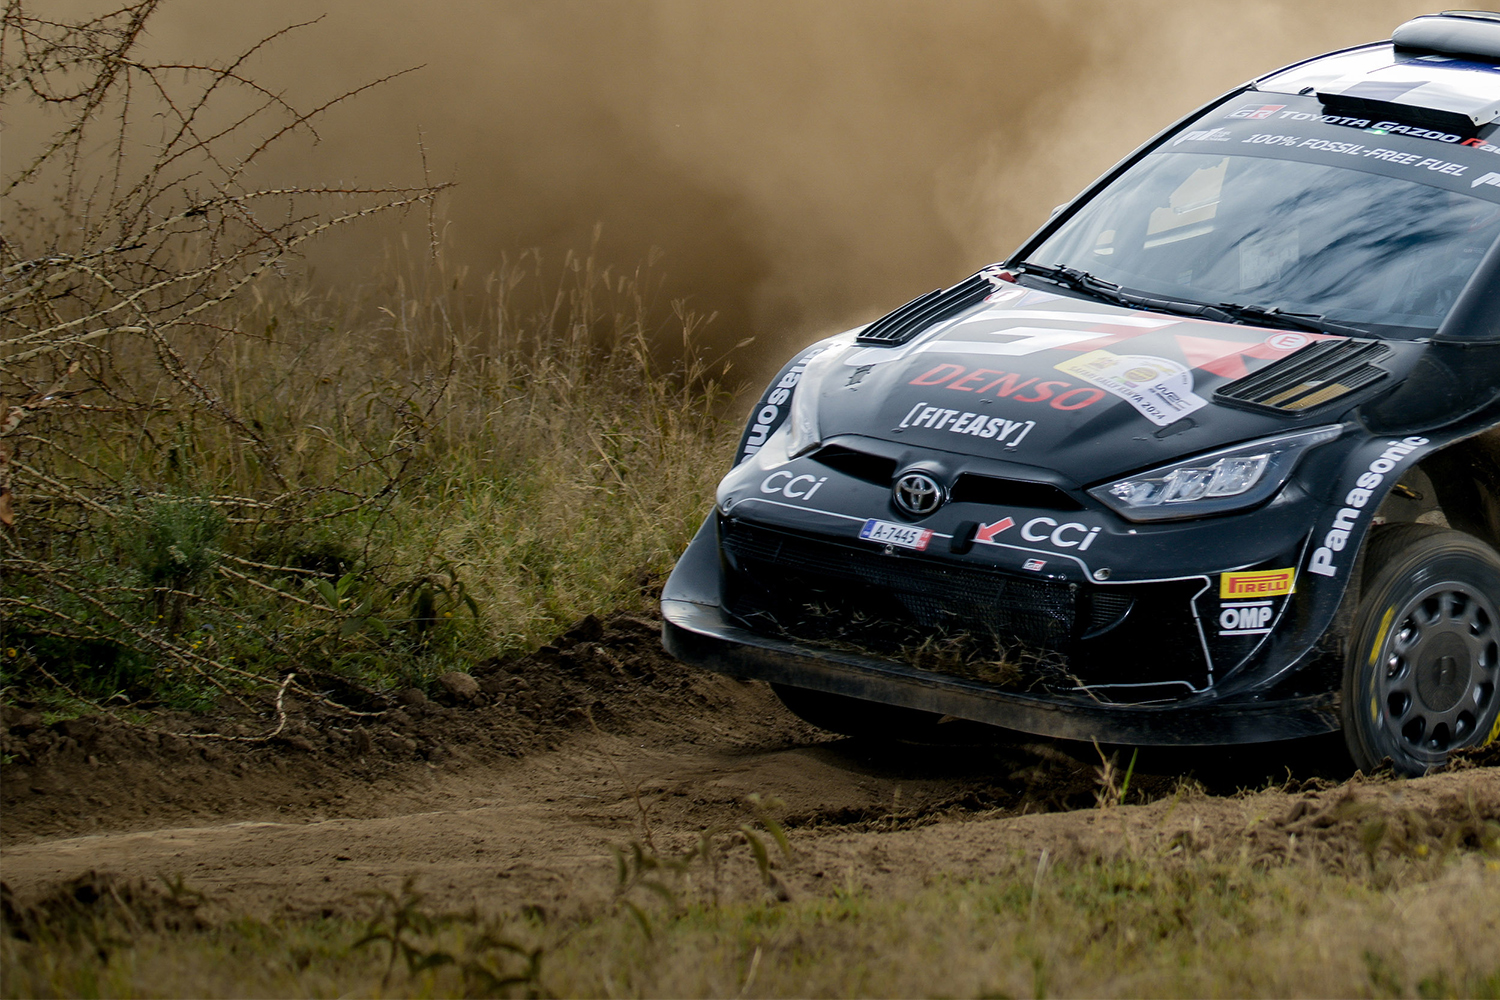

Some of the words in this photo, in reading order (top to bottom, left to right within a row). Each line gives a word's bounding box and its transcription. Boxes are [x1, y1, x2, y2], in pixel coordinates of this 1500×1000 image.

[1278, 110, 1371, 128] TOYOTA
[1371, 120, 1462, 144] GAZOO
[1242, 133, 1302, 147] 100%
[1297, 138, 1424, 165] FOSSIL-FREE
[1415, 157, 1470, 177] FUEL
[908, 363, 1106, 411] DENSO
[1141, 402, 1166, 420] 2024
[1308, 435, 1430, 577] Panasonic
[873, 524, 918, 545] A-7445
[1228, 573, 1290, 594] PIRELLI
[1219, 606, 1273, 630] OMP
